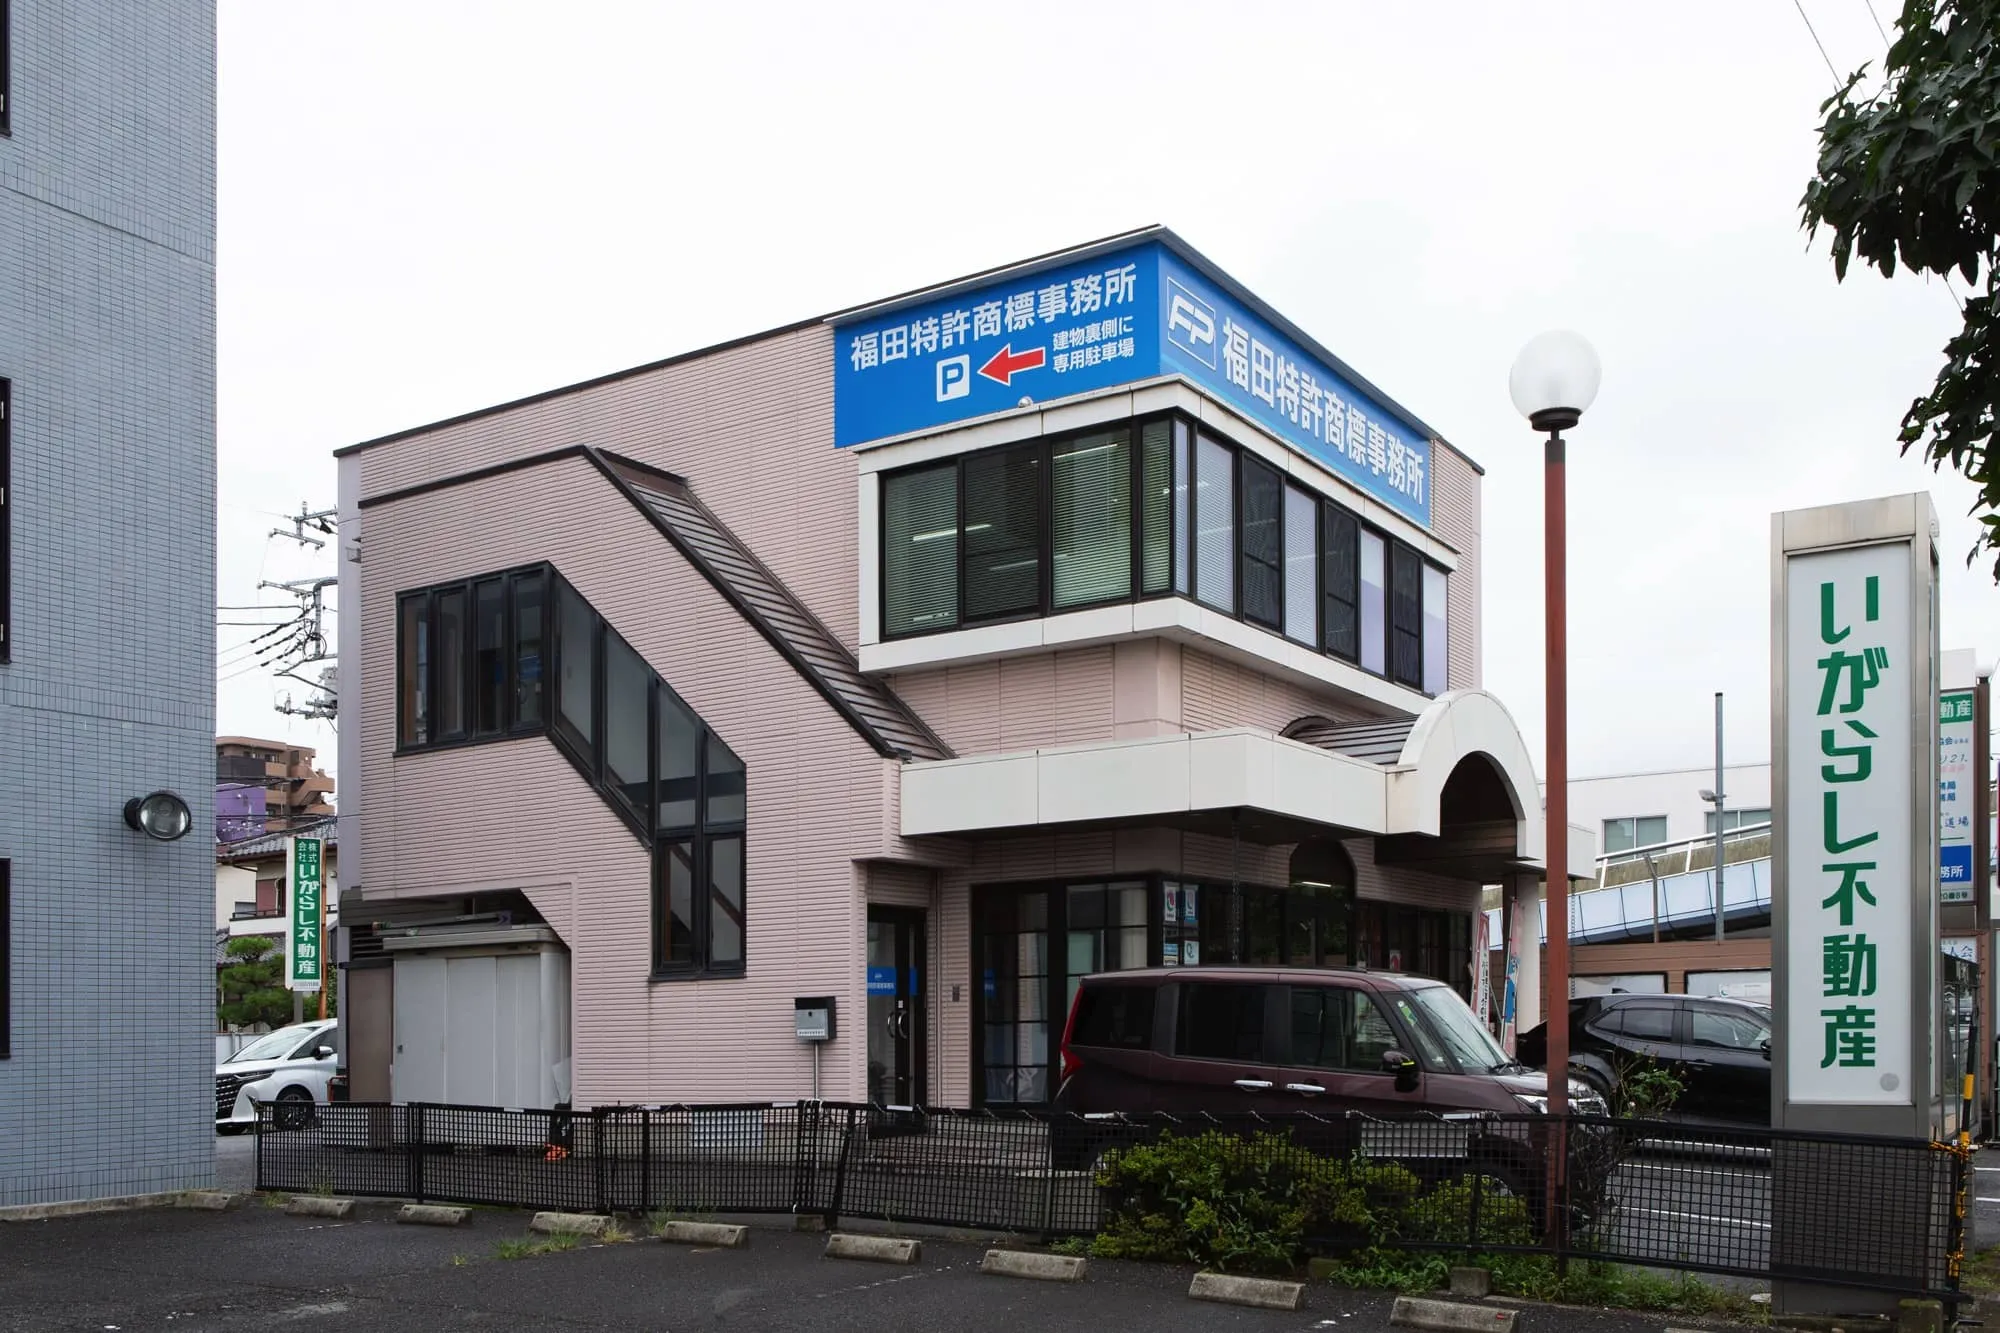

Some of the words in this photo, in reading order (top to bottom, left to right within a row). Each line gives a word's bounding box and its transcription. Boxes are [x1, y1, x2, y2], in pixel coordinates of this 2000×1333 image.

[851, 263, 1137, 372] 福田特許商標事務所
[1052, 315, 1134, 352] 建物裏側に
[1052, 338, 1134, 374] 専用駐車場
[1168, 294, 1215, 345] FP
[1221, 316, 1424, 506] 福田特許商標事務所
[1818, 576, 1889, 1069] いがらし不動産
[298, 864, 320, 974] いがらし不動産
